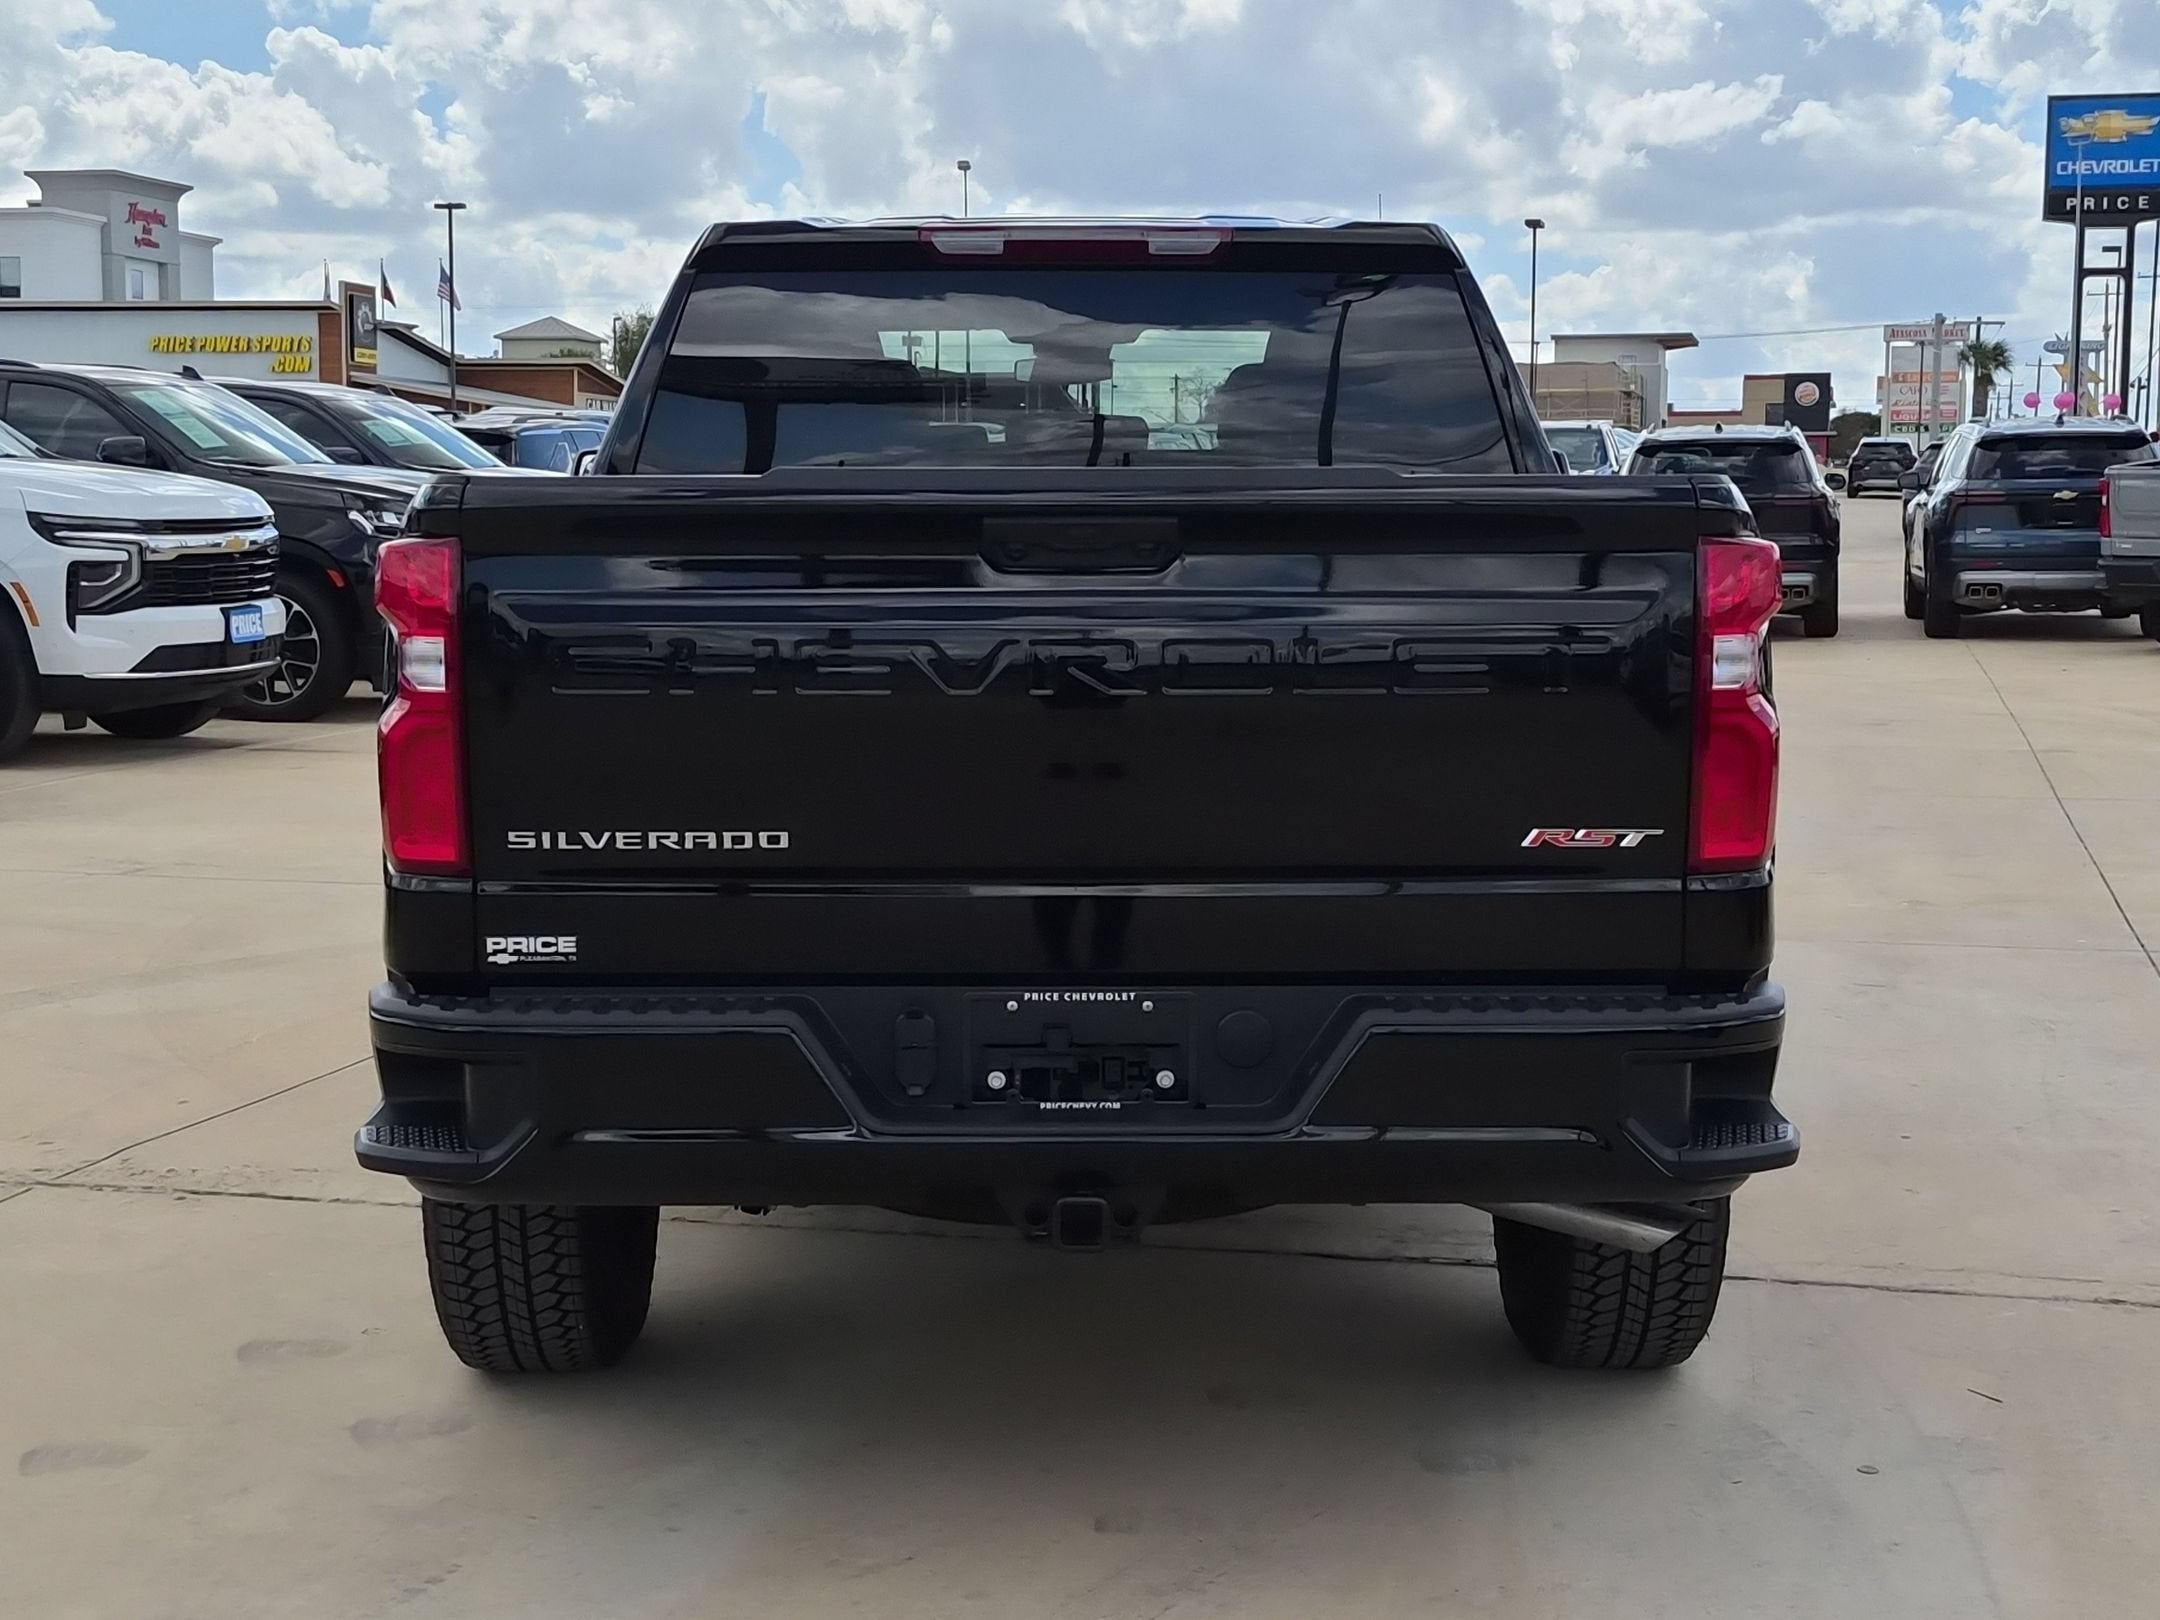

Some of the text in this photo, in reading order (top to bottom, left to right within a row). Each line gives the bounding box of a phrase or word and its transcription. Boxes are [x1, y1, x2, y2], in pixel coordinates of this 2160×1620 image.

[2056, 159, 2160, 175] CHEVROLET
[2066, 196, 2149, 210] PRICE
[152, 336, 313, 352] PRICE POWER SPORTS
[271, 355, 313, 373] .COM
[232, 612, 263, 637] PRICE
[550, 635, 1618, 695] CHEVROLET
[507, 831, 789, 849] SILVERADO
[1521, 828, 1665, 847] RST
[486, 937, 577, 953] PRICE
[1024, 992, 1136, 1001] PRICE CHEVROLET
